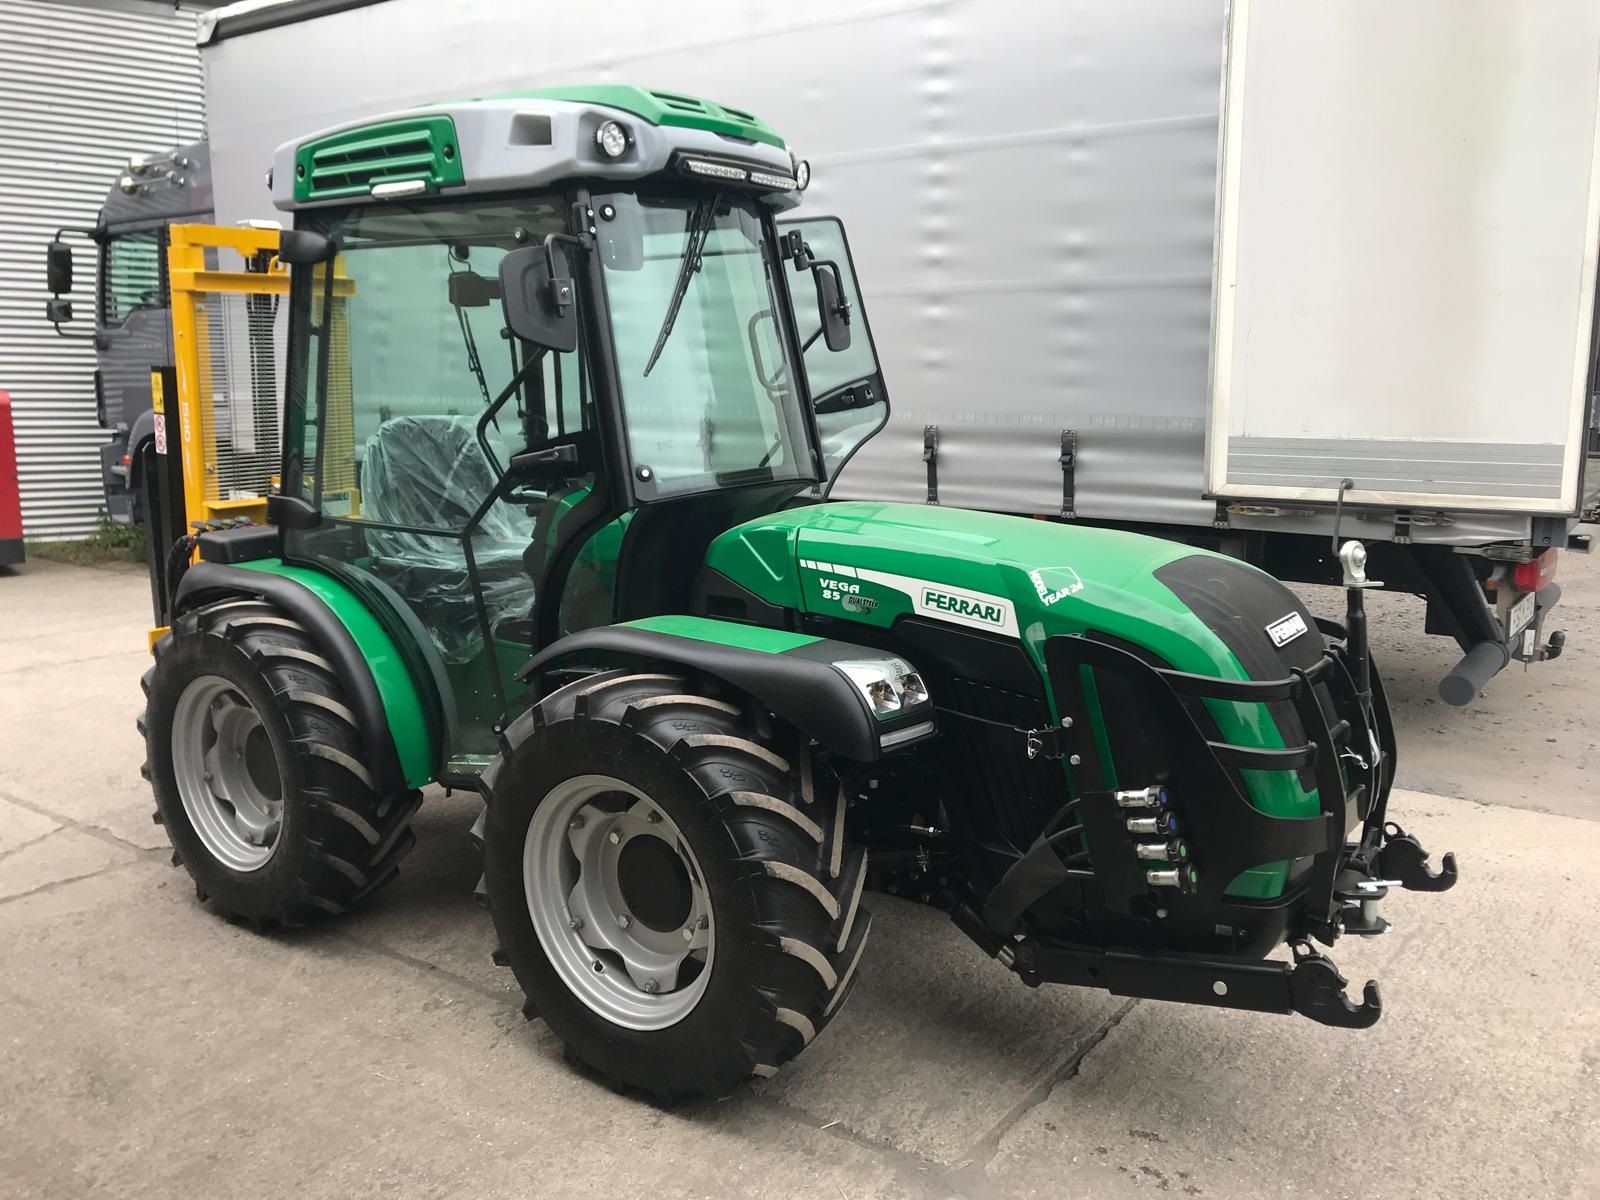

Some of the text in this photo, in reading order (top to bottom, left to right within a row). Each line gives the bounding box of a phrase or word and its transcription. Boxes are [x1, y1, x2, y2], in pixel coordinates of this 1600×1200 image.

[819, 578, 860, 594] VEGA
[1029, 569, 1048, 601] MODEL
[822, 589, 841, 600] 85
[848, 595, 880, 608] DUALSTEER
[1041, 587, 1070, 606] YEAR
[925, 591, 1002, 623] FERRARI
